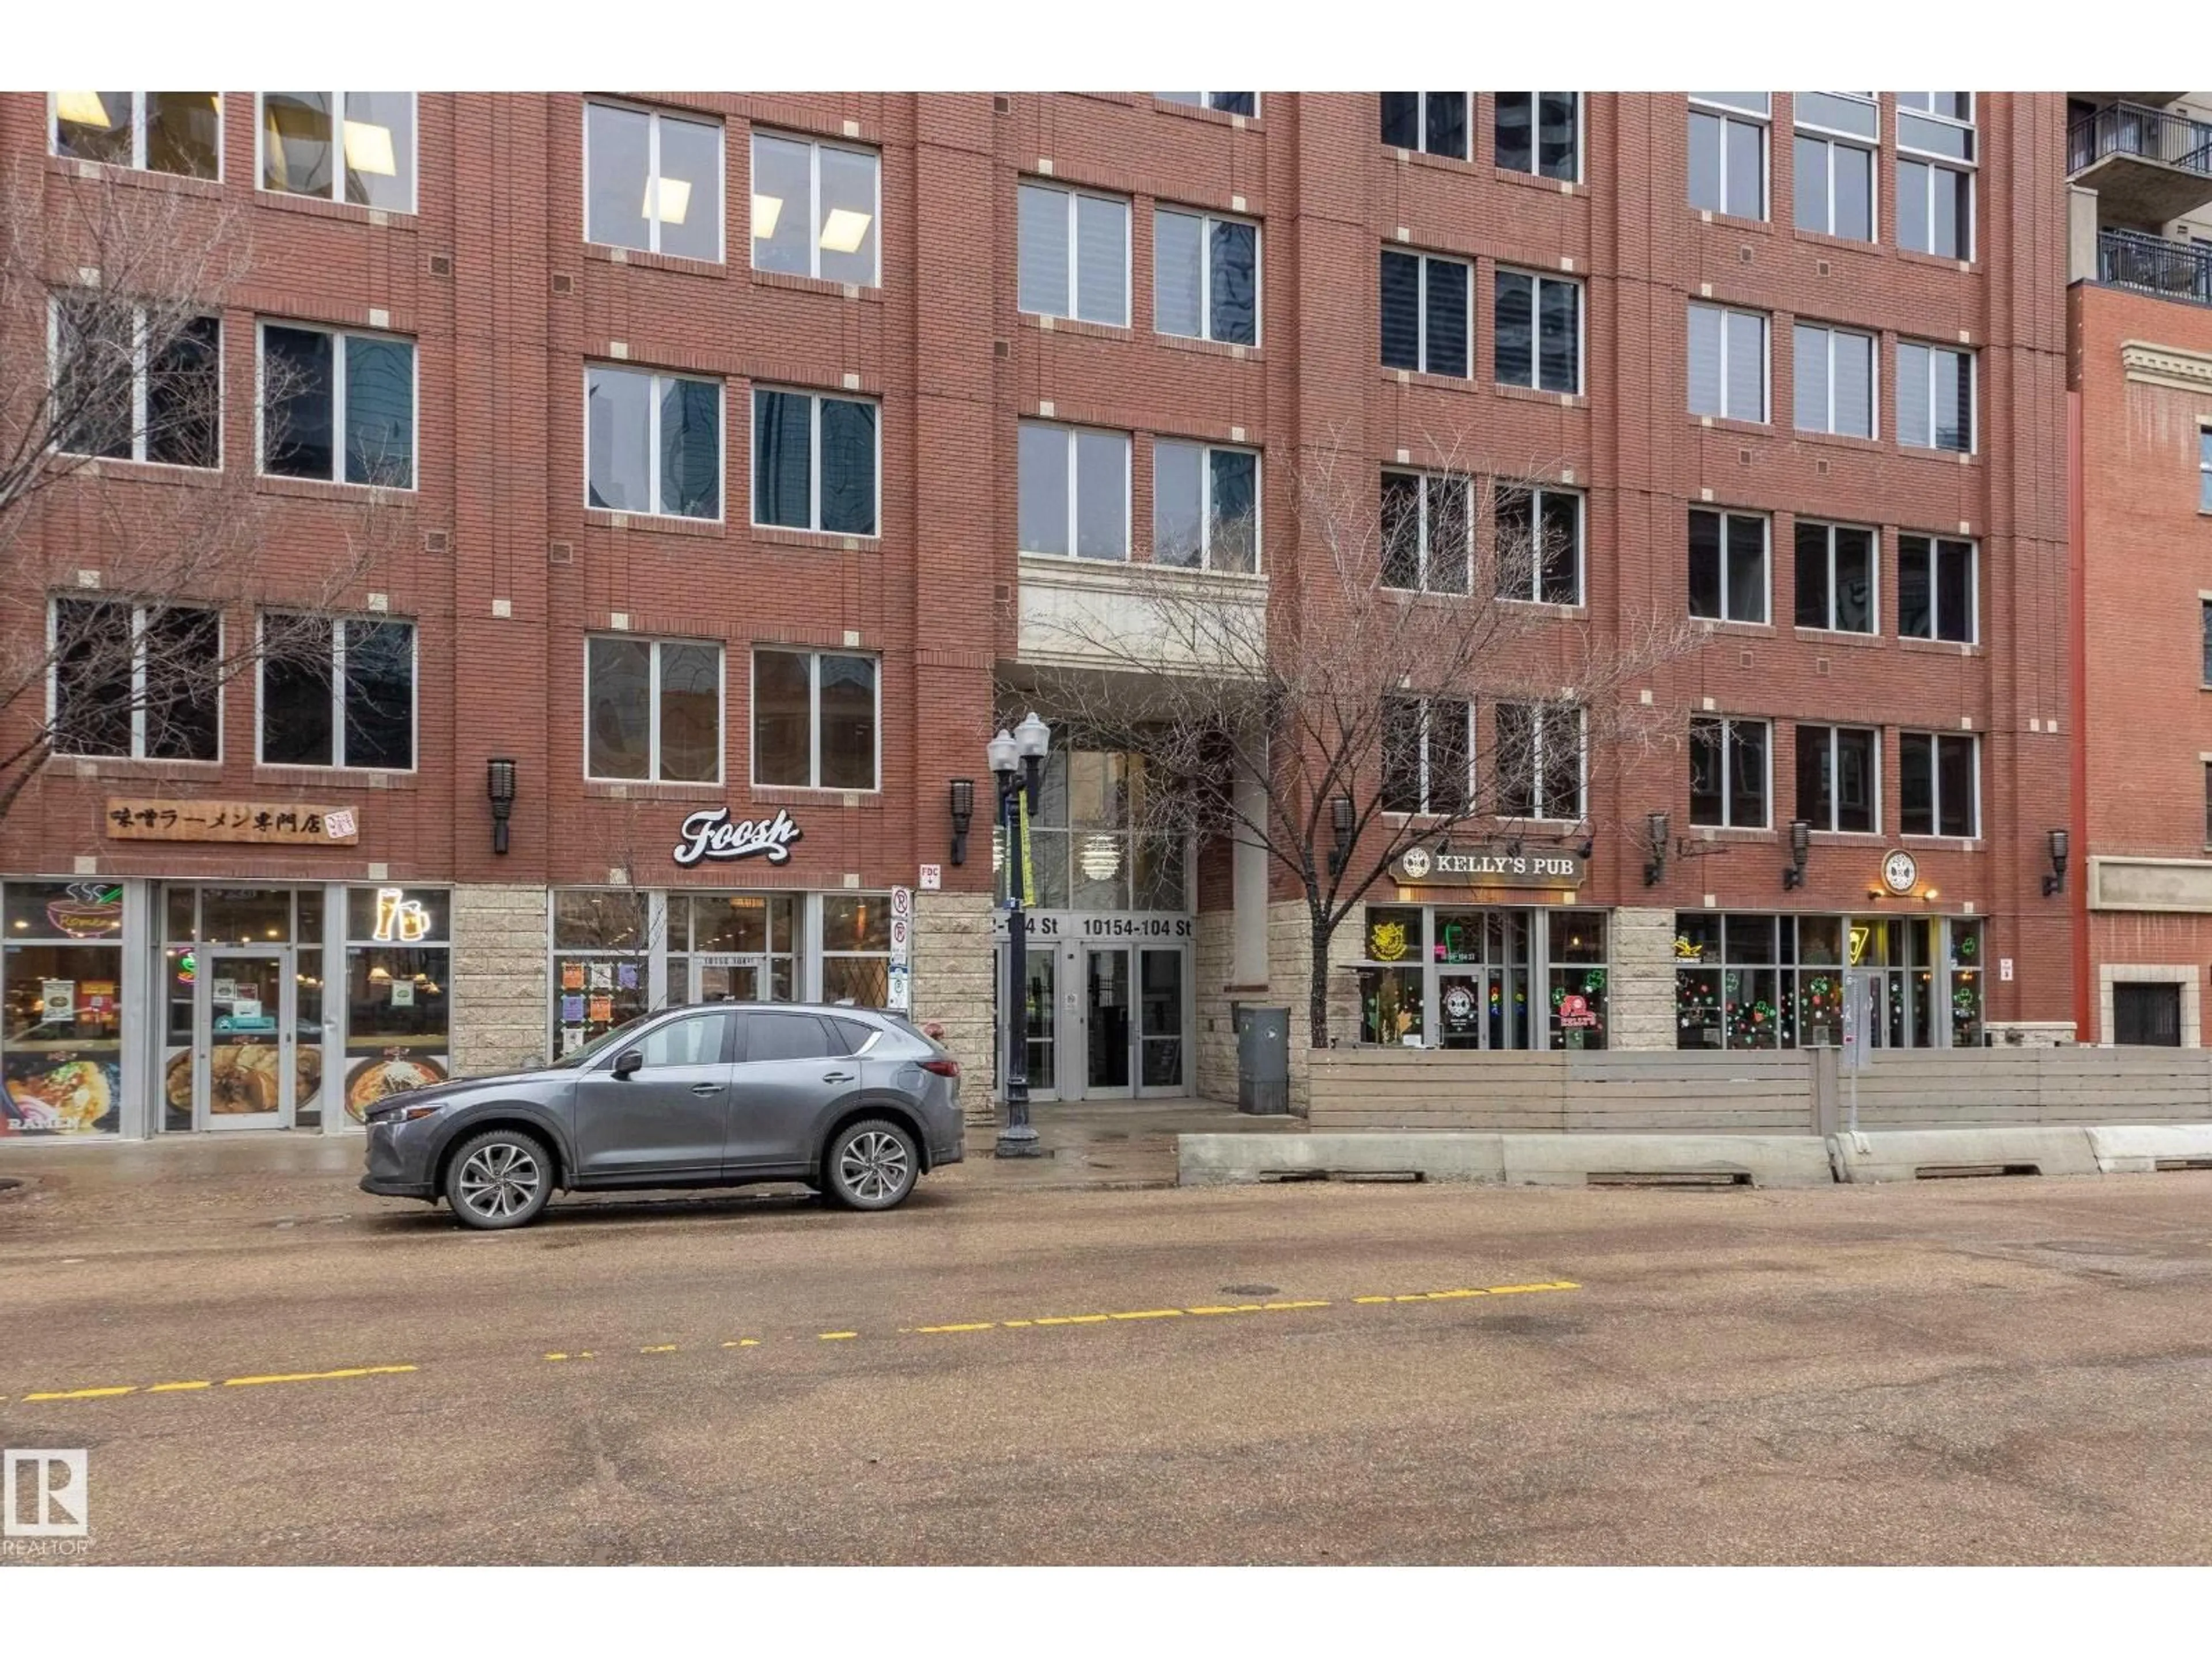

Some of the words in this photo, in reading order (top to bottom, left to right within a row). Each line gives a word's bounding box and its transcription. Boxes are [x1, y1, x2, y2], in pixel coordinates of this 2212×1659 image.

[673, 806, 801, 864] Foosh
[922, 867, 938, 876] FDC
[1437, 855, 1526, 874] KELLY'S
[1533, 858, 1574, 874] PUB
[1041, 917, 1059, 934] St
[1084, 919, 1171, 935] 10154-104
[1176, 920, 1192, 936] St
[7, 1117, 79, 1131] RAMEN
